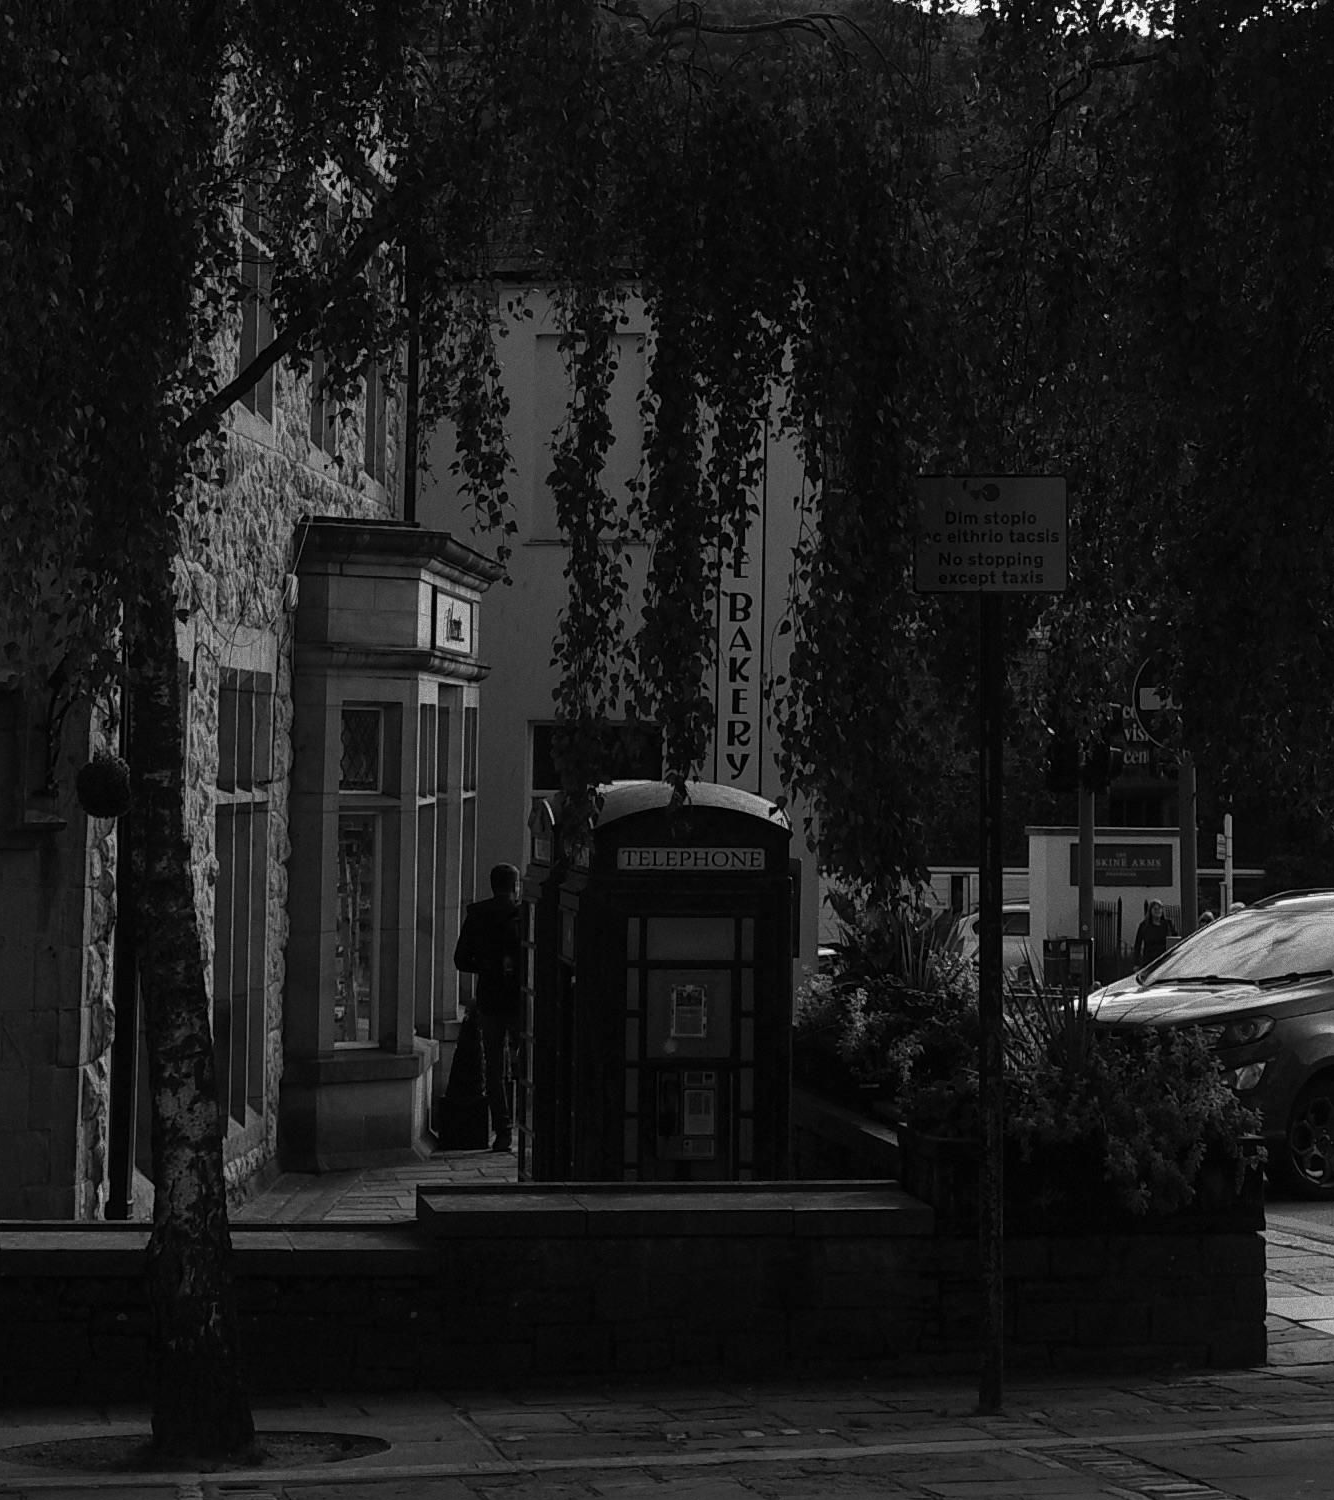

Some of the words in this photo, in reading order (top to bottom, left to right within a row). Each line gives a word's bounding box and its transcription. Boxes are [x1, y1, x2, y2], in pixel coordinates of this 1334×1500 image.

[945, 511, 978, 525] Dim
[984, 511, 1037, 527] stopio
[947, 529, 1004, 543] eithrio
[1010, 529, 1060, 543] tacsis
[938, 552, 963, 566] No
[968, 552, 1044, 568] stopping
[938, 571, 997, 587] except
[1002, 571, 1044, 585] taxis
[726, 592, 753, 780] BAKERY
[622, 850, 762, 868] TELEPHONE
[1095, 858, 1127, 868] SKINE
[1131, 858, 1162, 868] ARMS
